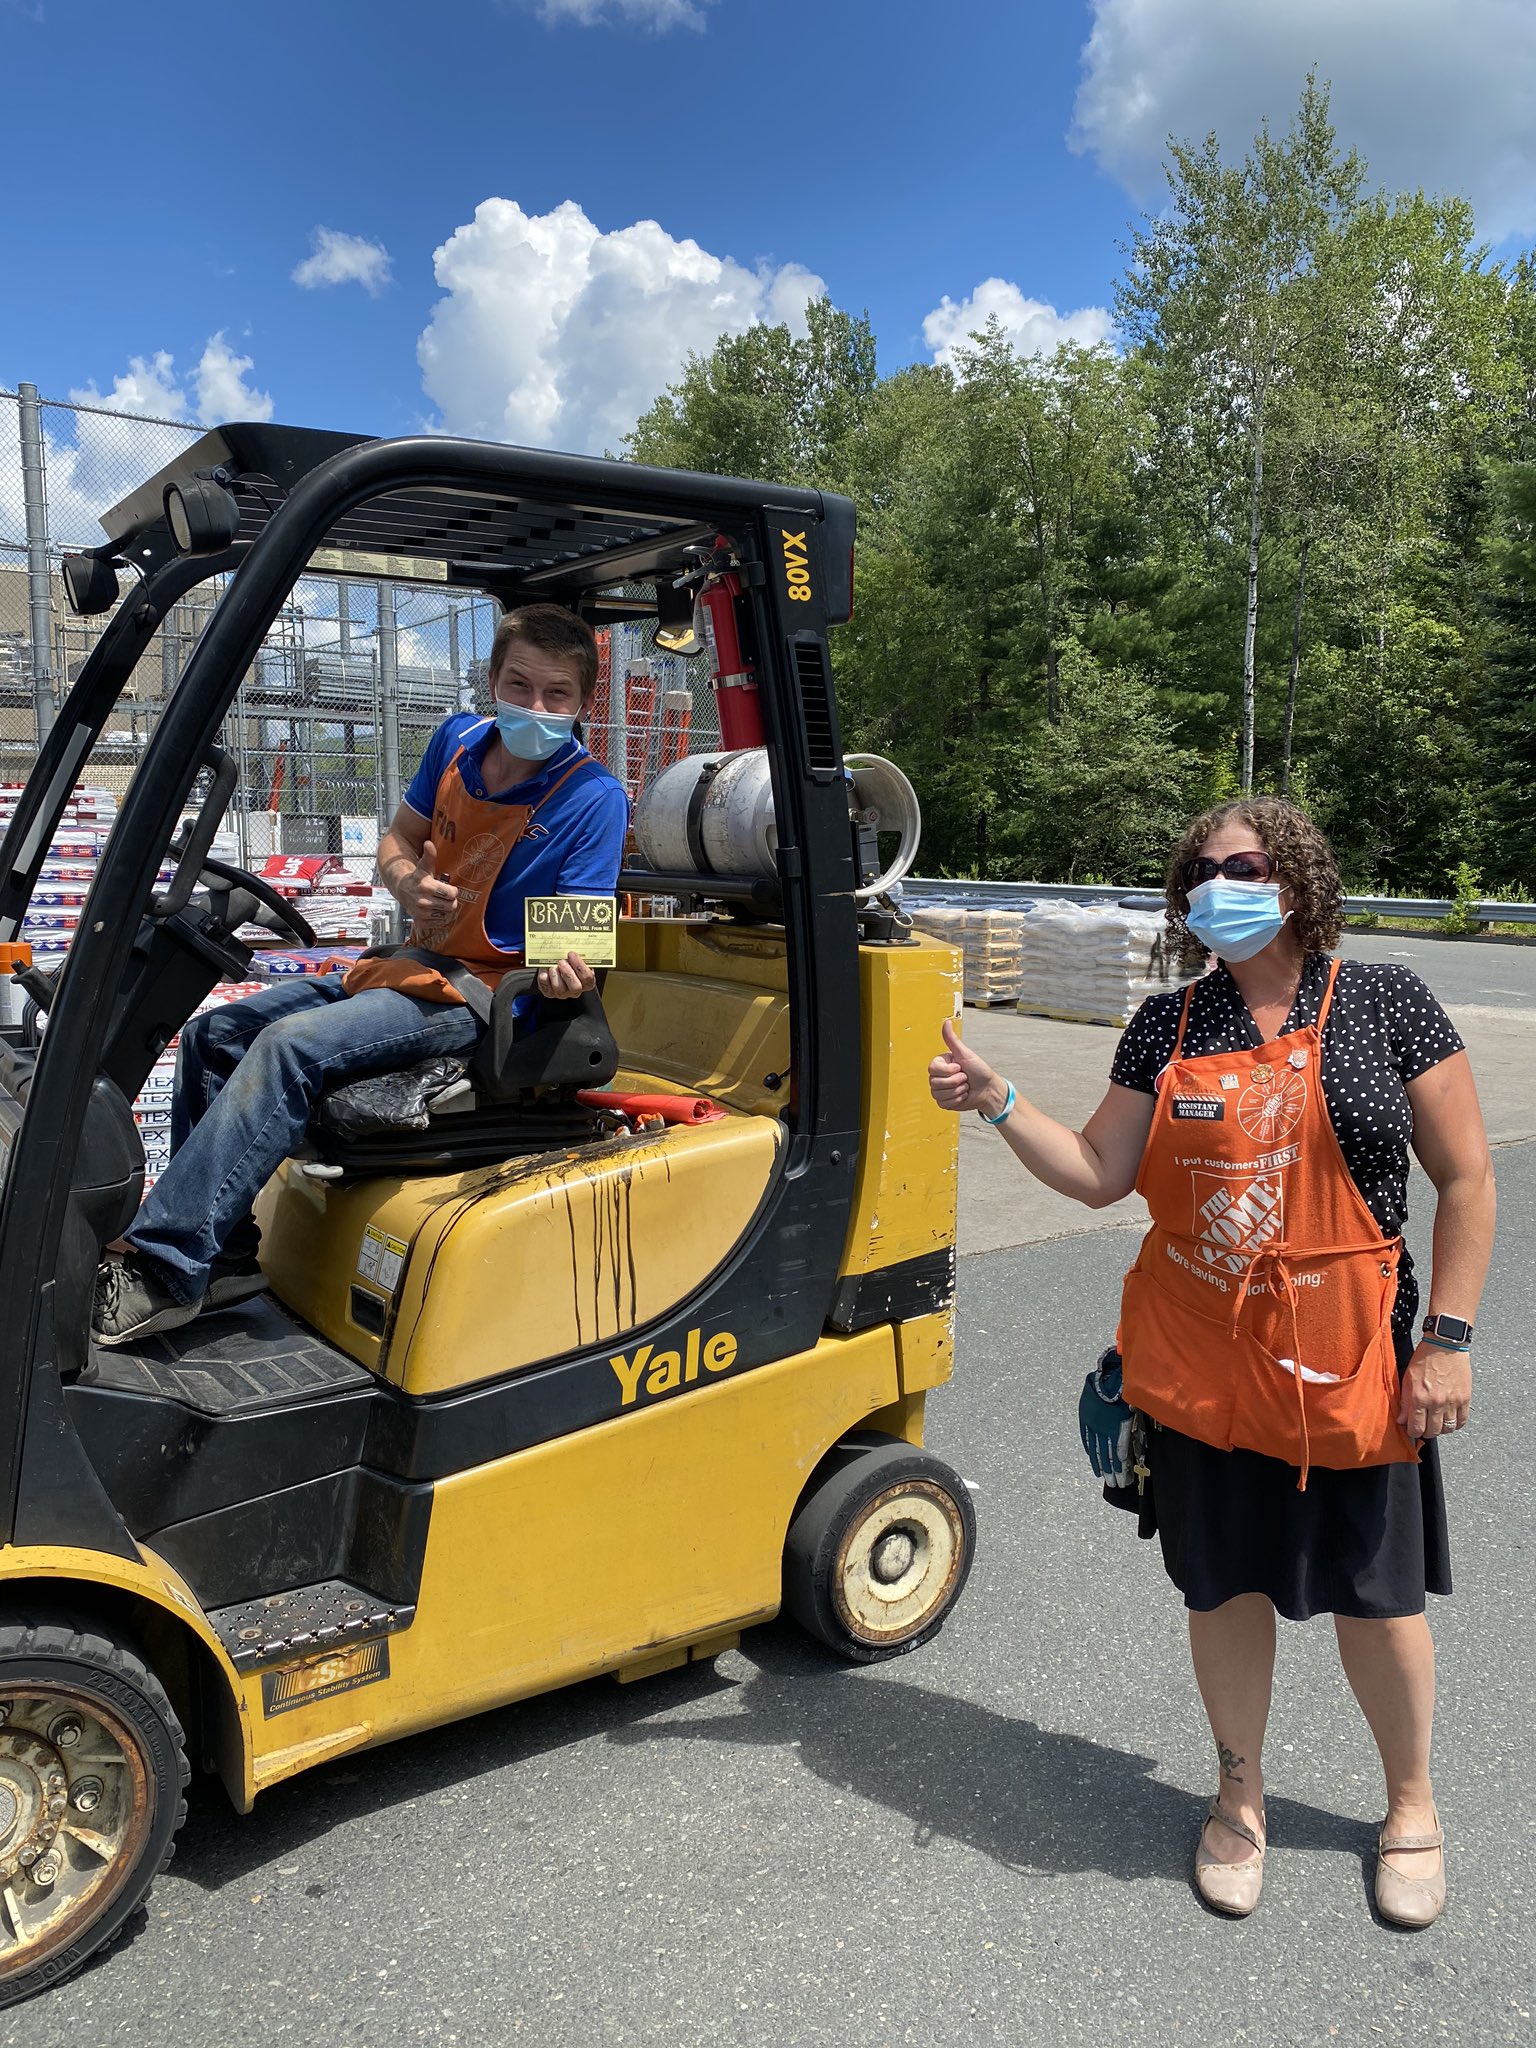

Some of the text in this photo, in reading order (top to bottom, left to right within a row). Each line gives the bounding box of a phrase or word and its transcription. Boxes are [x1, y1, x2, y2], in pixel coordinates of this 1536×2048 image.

[781, 529, 812, 602] 80VX
[278, 857, 304, 876] GAF
[530, 900, 613, 925] BRAVO
[1177, 1102, 1219, 1111] ASSISTANT
[1178, 1109, 1215, 1118] MANAGER
[1174, 1147, 1298, 1170] I put customers FIRST
[1199, 1187, 1235, 1223] THE
[1200, 1175, 1283, 1264] HOME
[1166, 1243, 1190, 1269] More
[1190, 1263, 1231, 1292] saving.
[609, 1328, 738, 1406] Yale
[269, 1671, 381, 1712] Continuous Stability System
